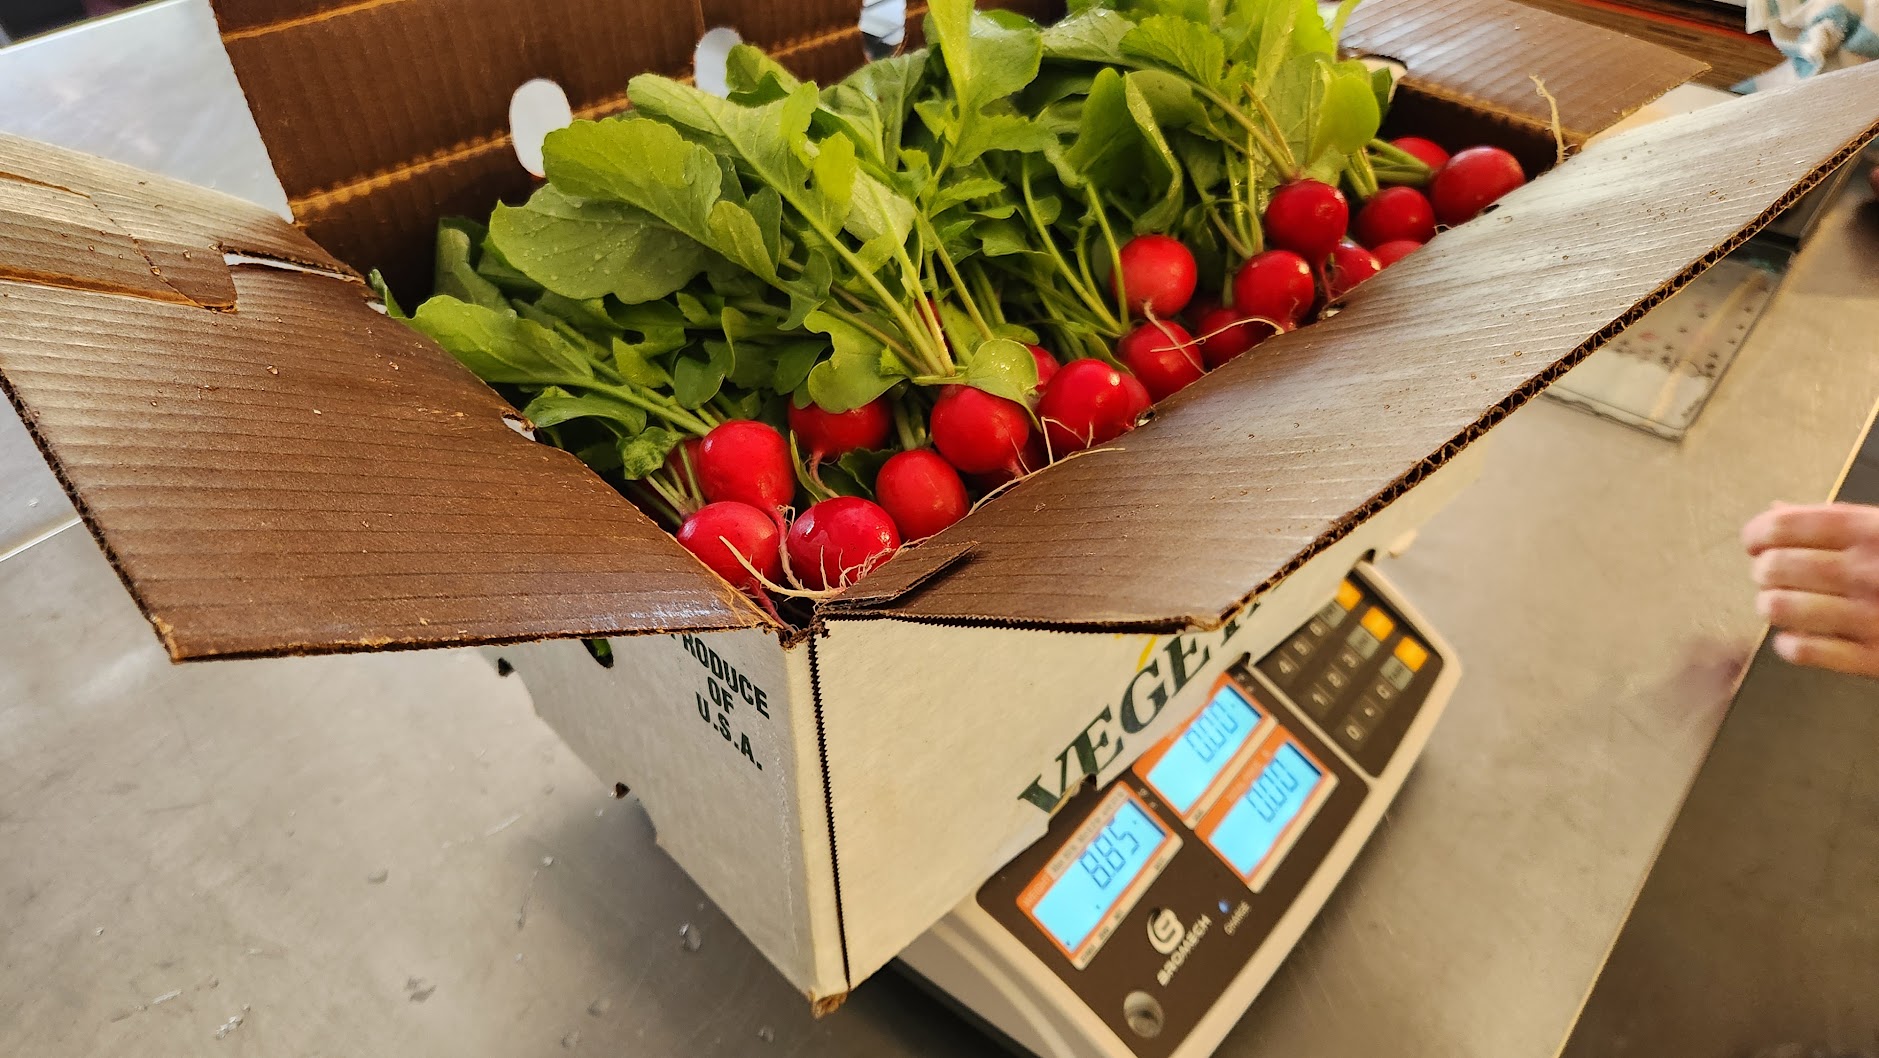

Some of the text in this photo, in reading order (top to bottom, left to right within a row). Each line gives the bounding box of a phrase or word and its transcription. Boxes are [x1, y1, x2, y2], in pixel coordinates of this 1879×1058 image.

[670, 633, 770, 720] RODUCE
[707, 676, 734, 714] OF
[1278, 659, 1293, 674] 4
[1017, 579, 1288, 814] VEGE
[695, 691, 763, 771] U.S.A.
[1345, 725, 1363, 741] 0
